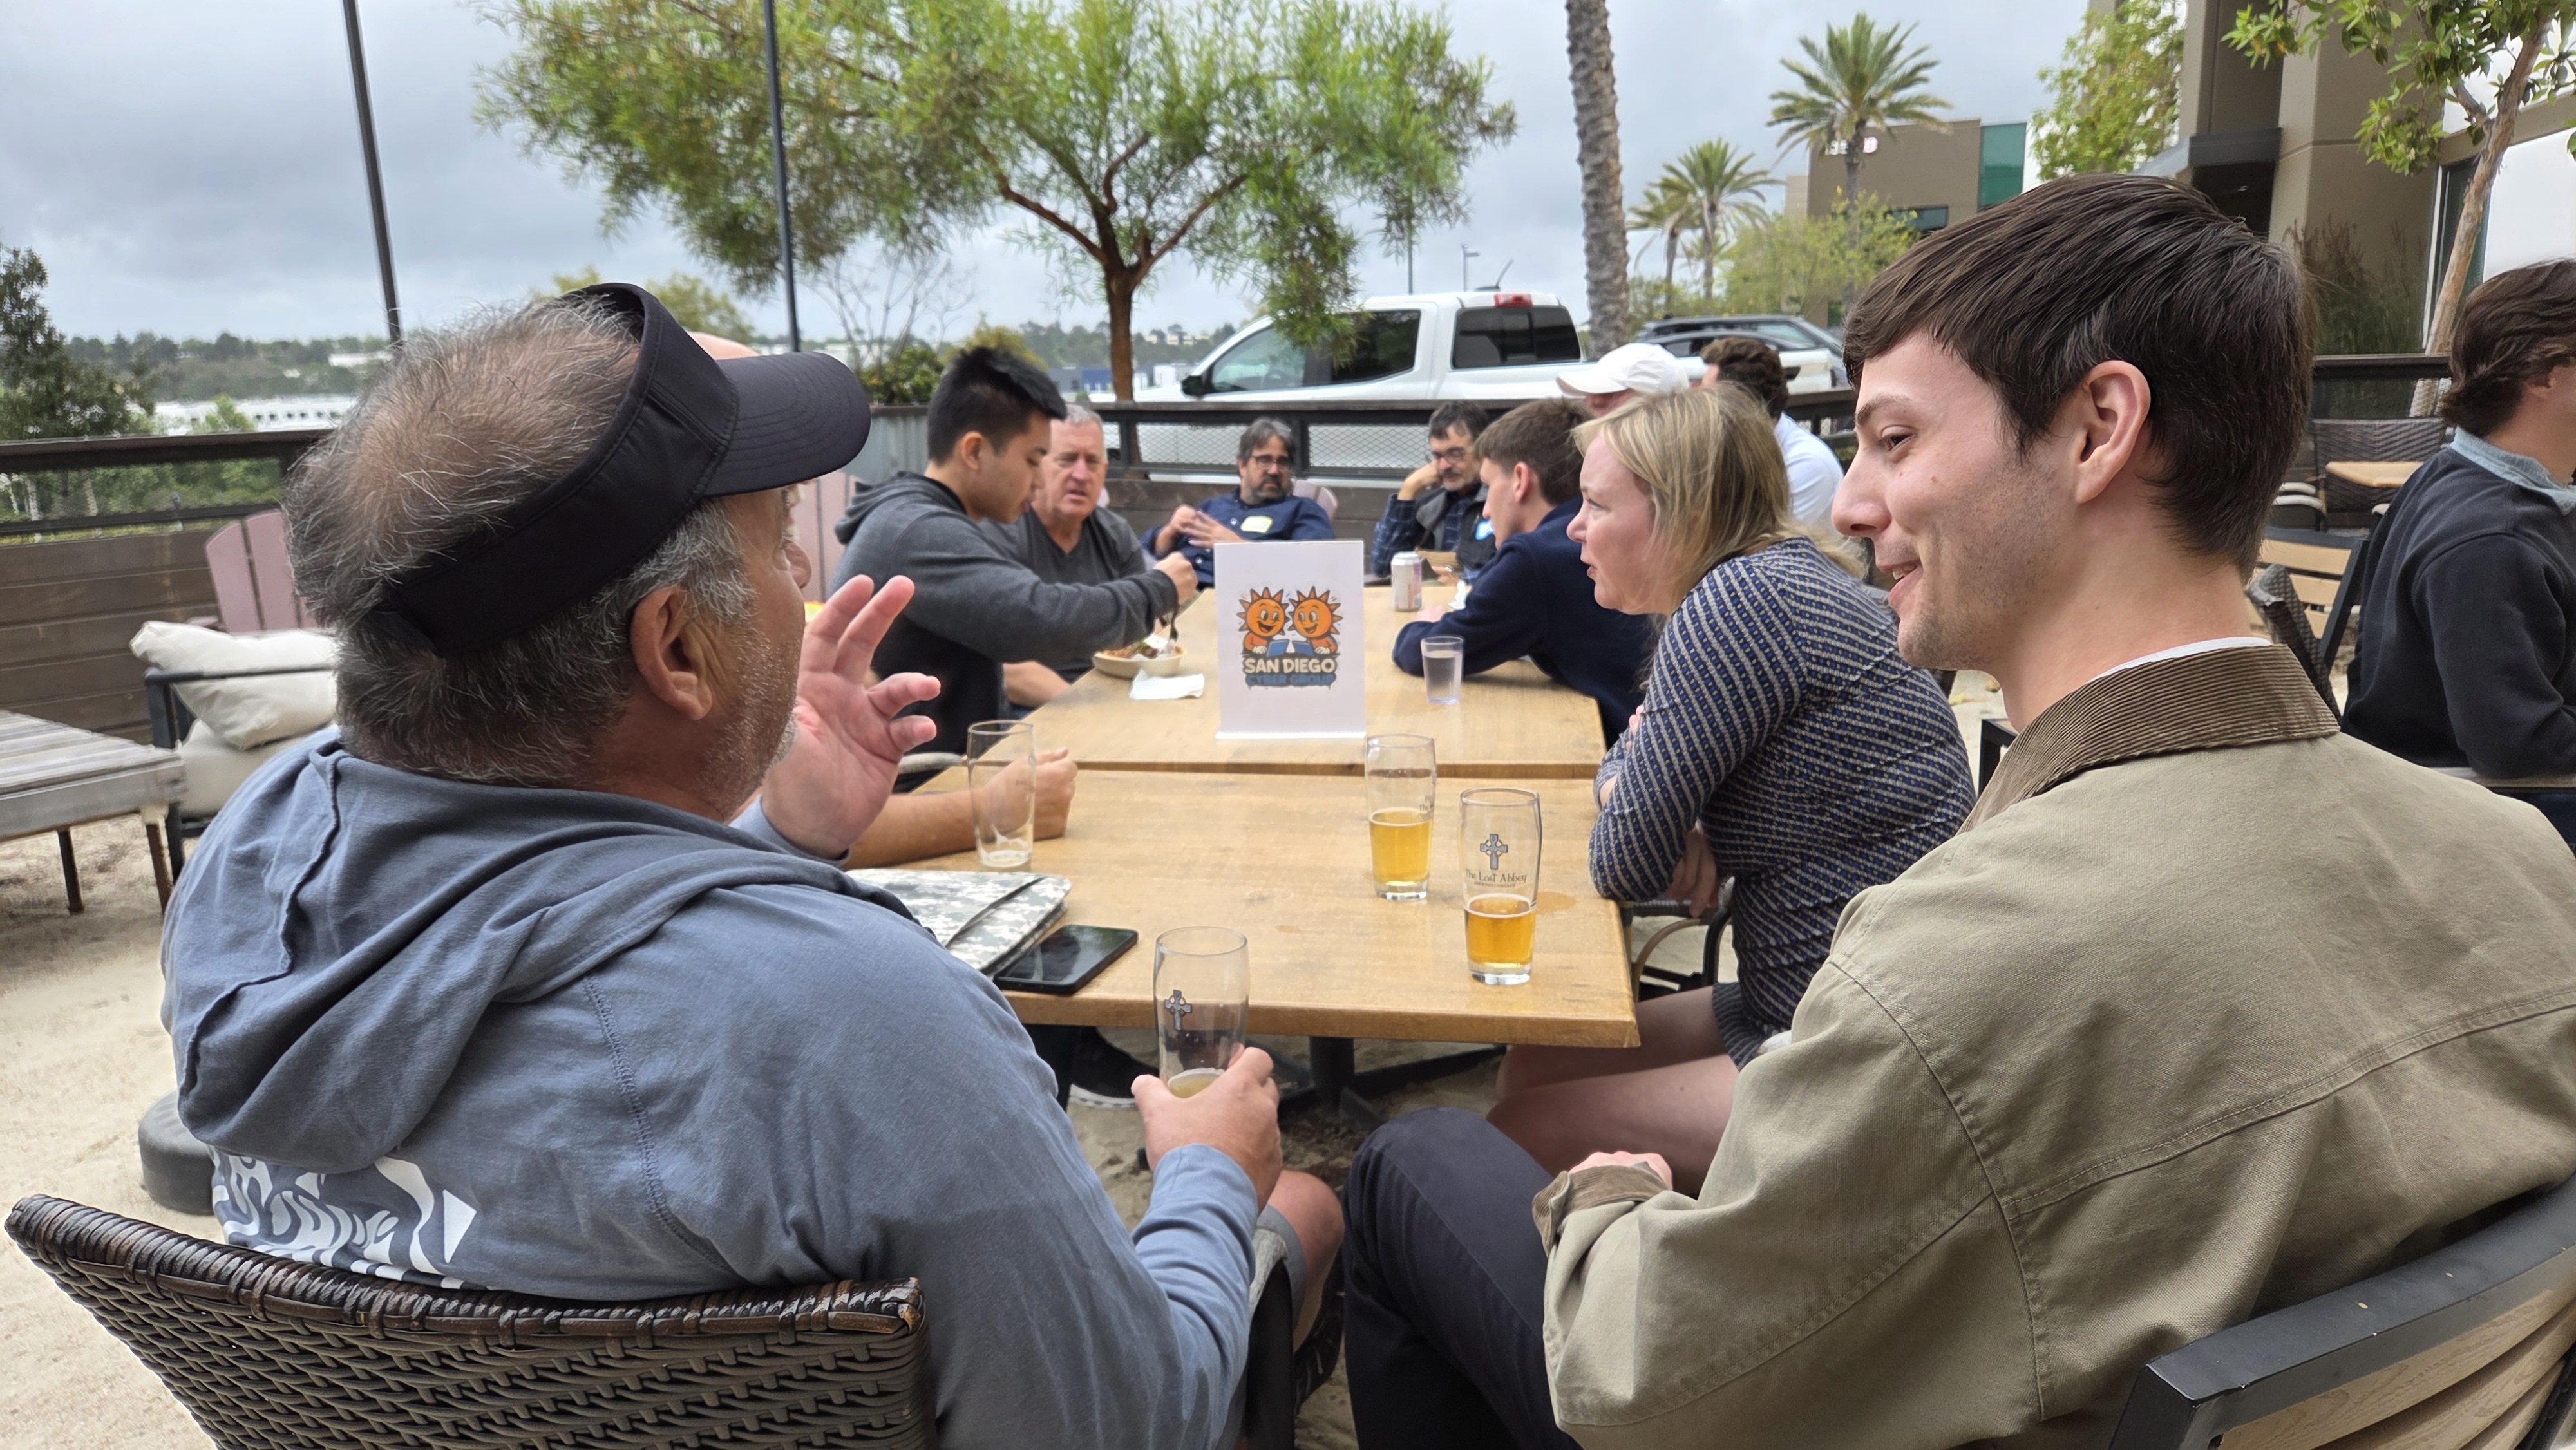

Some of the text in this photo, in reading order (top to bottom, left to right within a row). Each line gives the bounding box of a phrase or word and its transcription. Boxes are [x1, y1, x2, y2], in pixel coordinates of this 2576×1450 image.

[1244, 658, 1336, 673] SAN DIEGO
[1500, 872, 1527, 884] Abbey
